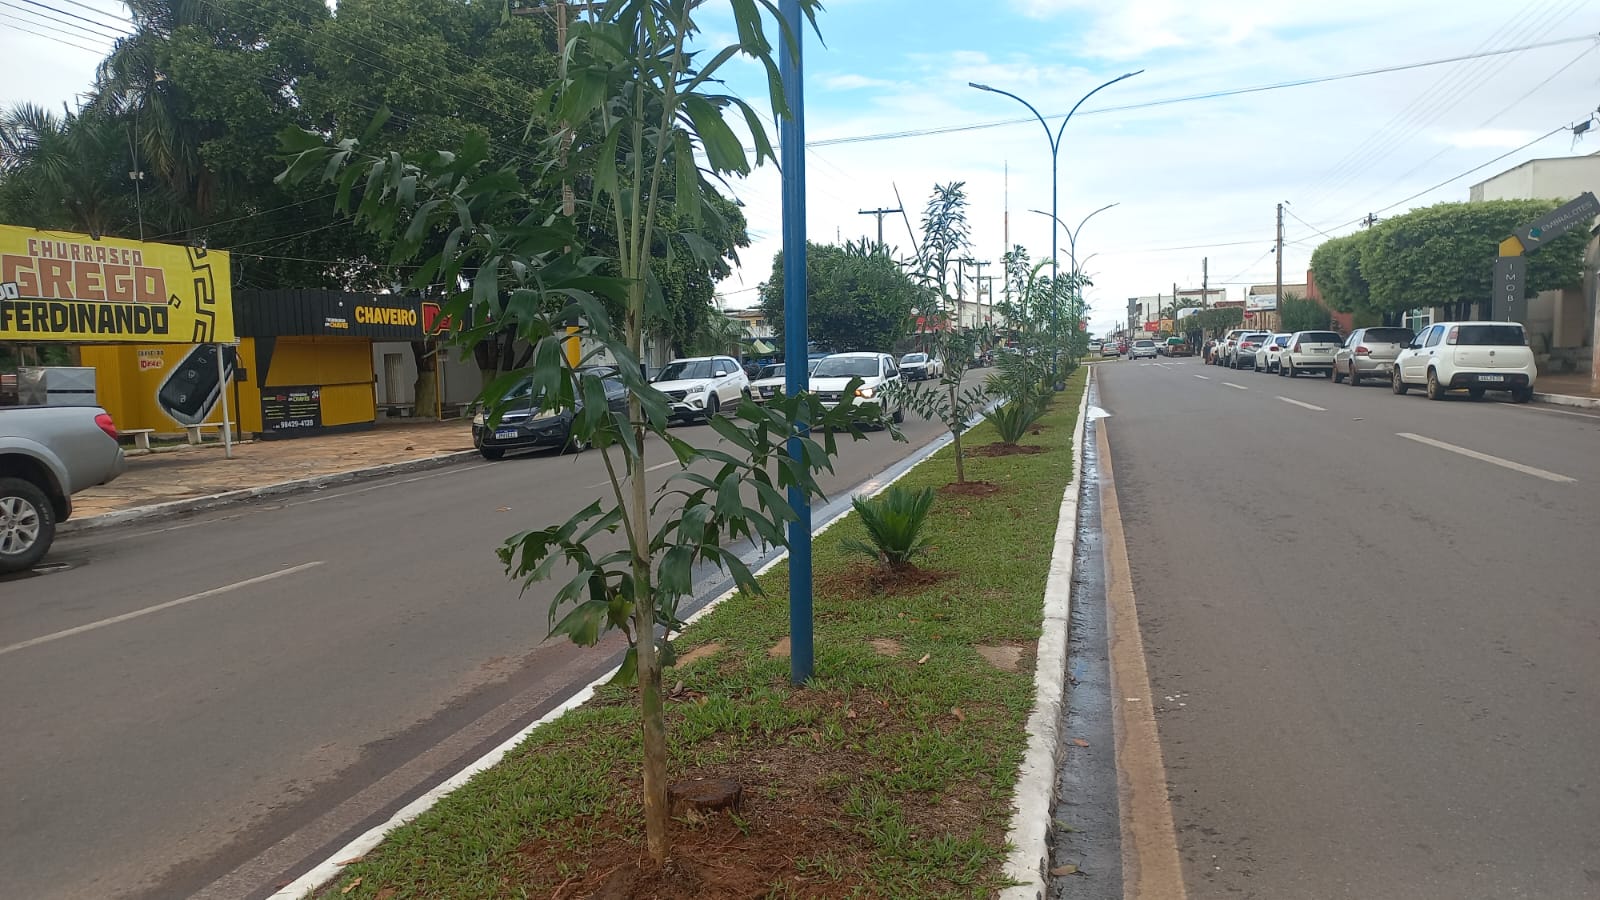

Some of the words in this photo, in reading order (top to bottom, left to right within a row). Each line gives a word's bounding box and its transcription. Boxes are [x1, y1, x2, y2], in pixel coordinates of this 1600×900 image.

[28, 239, 143, 266] CHURRASCO
[2, 255, 168, 302] GREGO
[1, 302, 168, 334] FERDINANDO
[355, 306, 417, 326] CHAVEIRO
